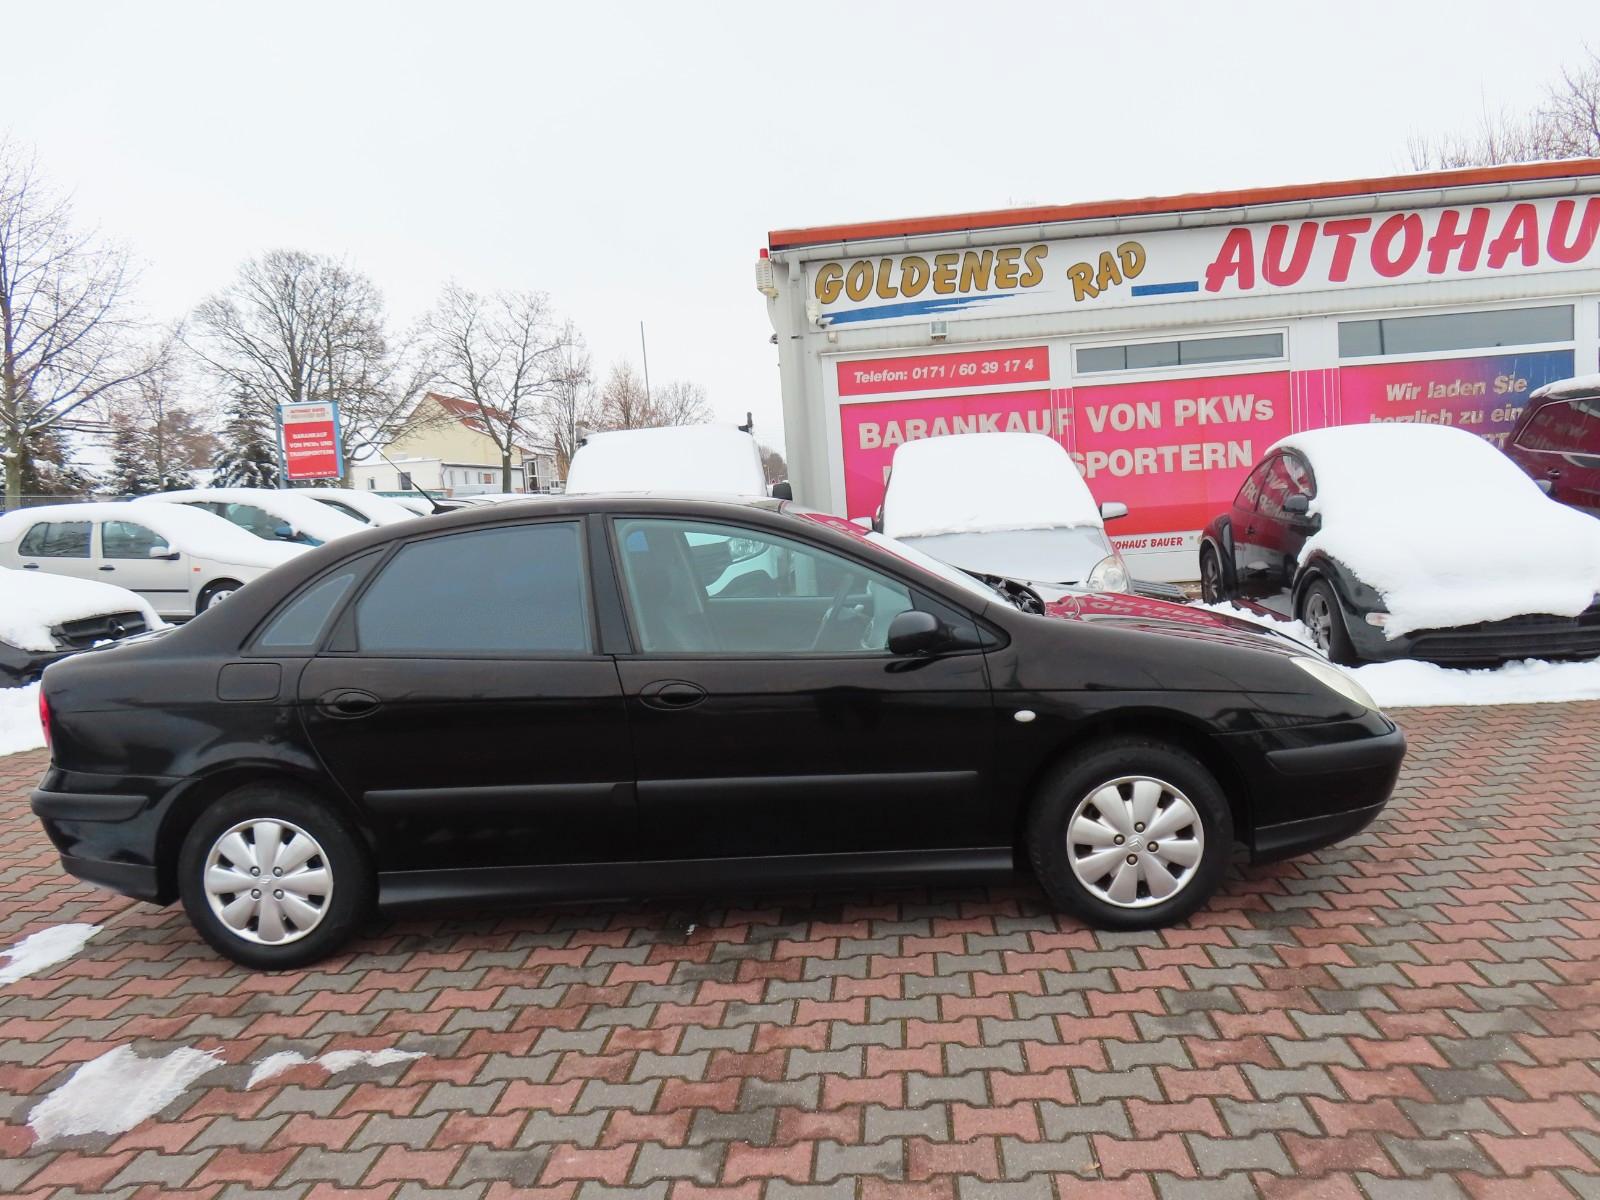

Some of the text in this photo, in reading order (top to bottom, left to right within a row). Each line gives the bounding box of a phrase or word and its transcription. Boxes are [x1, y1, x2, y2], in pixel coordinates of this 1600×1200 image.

[815, 197, 1600, 304] GOLDENES RAD AUTOHAU
[854, 369, 908, 384] Telefon:
[912, 366, 945, 379] 0171
[959, 363, 977, 375] 60
[981, 361, 999, 373] 39
[1004, 360, 1020, 372] 17
[1025, 358, 1034, 370] 4
[1386, 373, 1528, 402] Wir laden Sie
[859, 394, 1274, 449] BARANKAUF VON PKWs
[1459, 409, 1483, 425] zu
[1491, 403, 1524, 422] ein
[1070, 440, 1253, 479] SPORTERN
[1112, 537, 1183, 550] OHAUS BAUER
